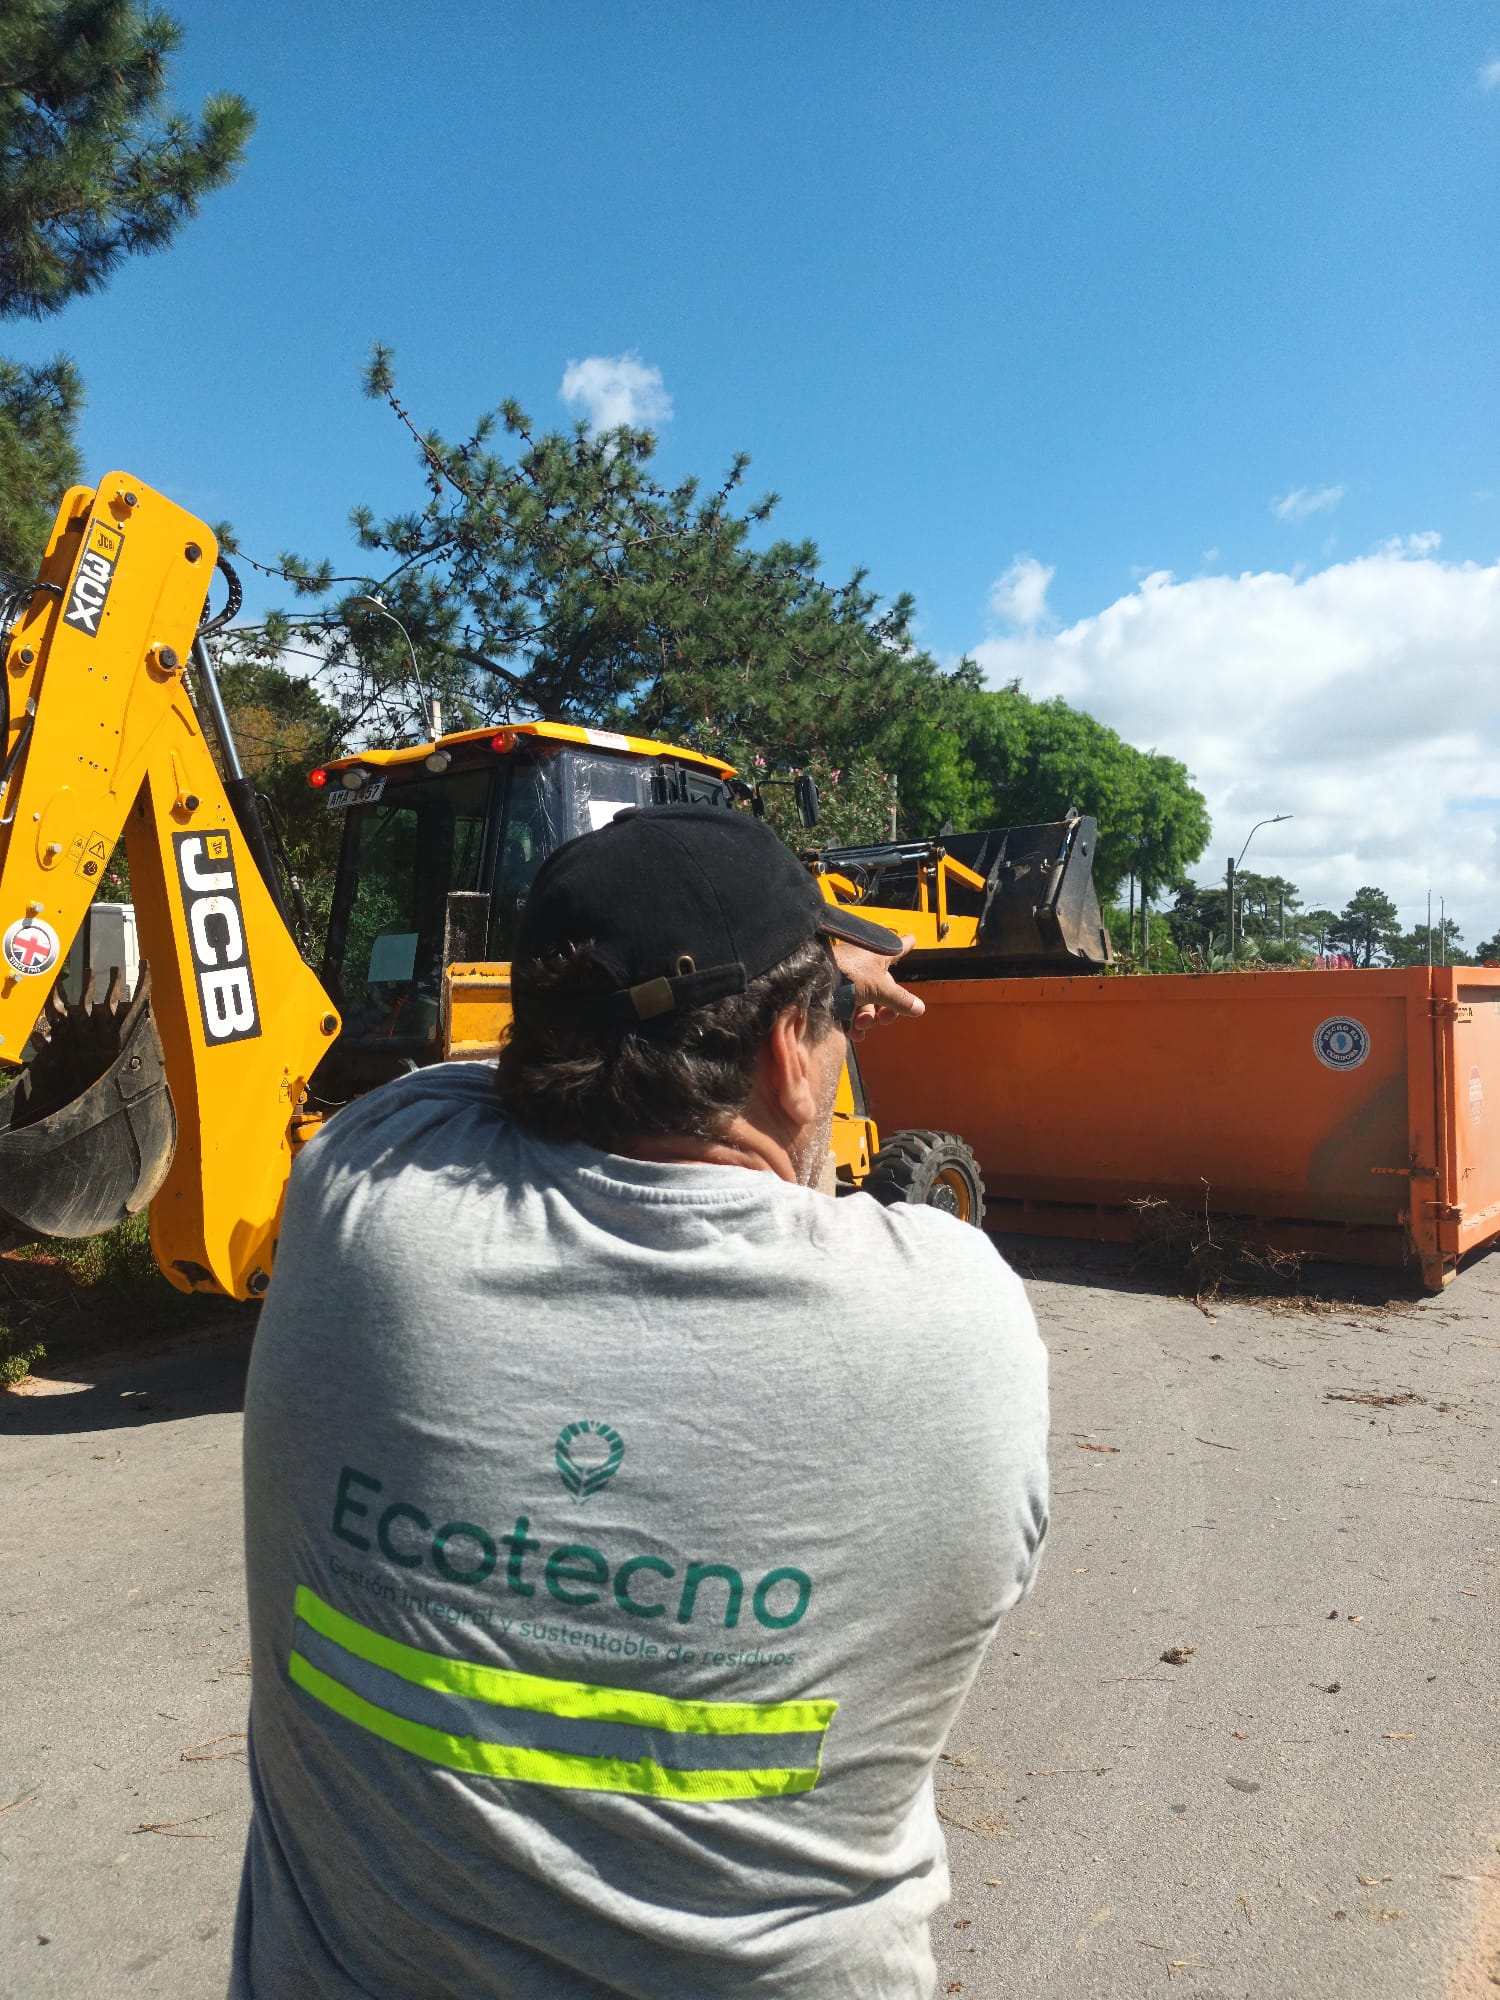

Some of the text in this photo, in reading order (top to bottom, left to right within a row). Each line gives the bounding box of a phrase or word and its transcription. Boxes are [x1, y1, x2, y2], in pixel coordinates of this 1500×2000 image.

[97, 533, 114, 551] JCB
[65, 552, 111, 632] 3CX
[180, 837, 255, 1038] JCB
[331, 1466, 812, 1630] Ecotecno
[501, 1619, 514, 1634] y
[519, 1621, 659, 1659] sustentable
[666, 1644, 695, 1665] de
[701, 1648, 796, 1667] residuos
